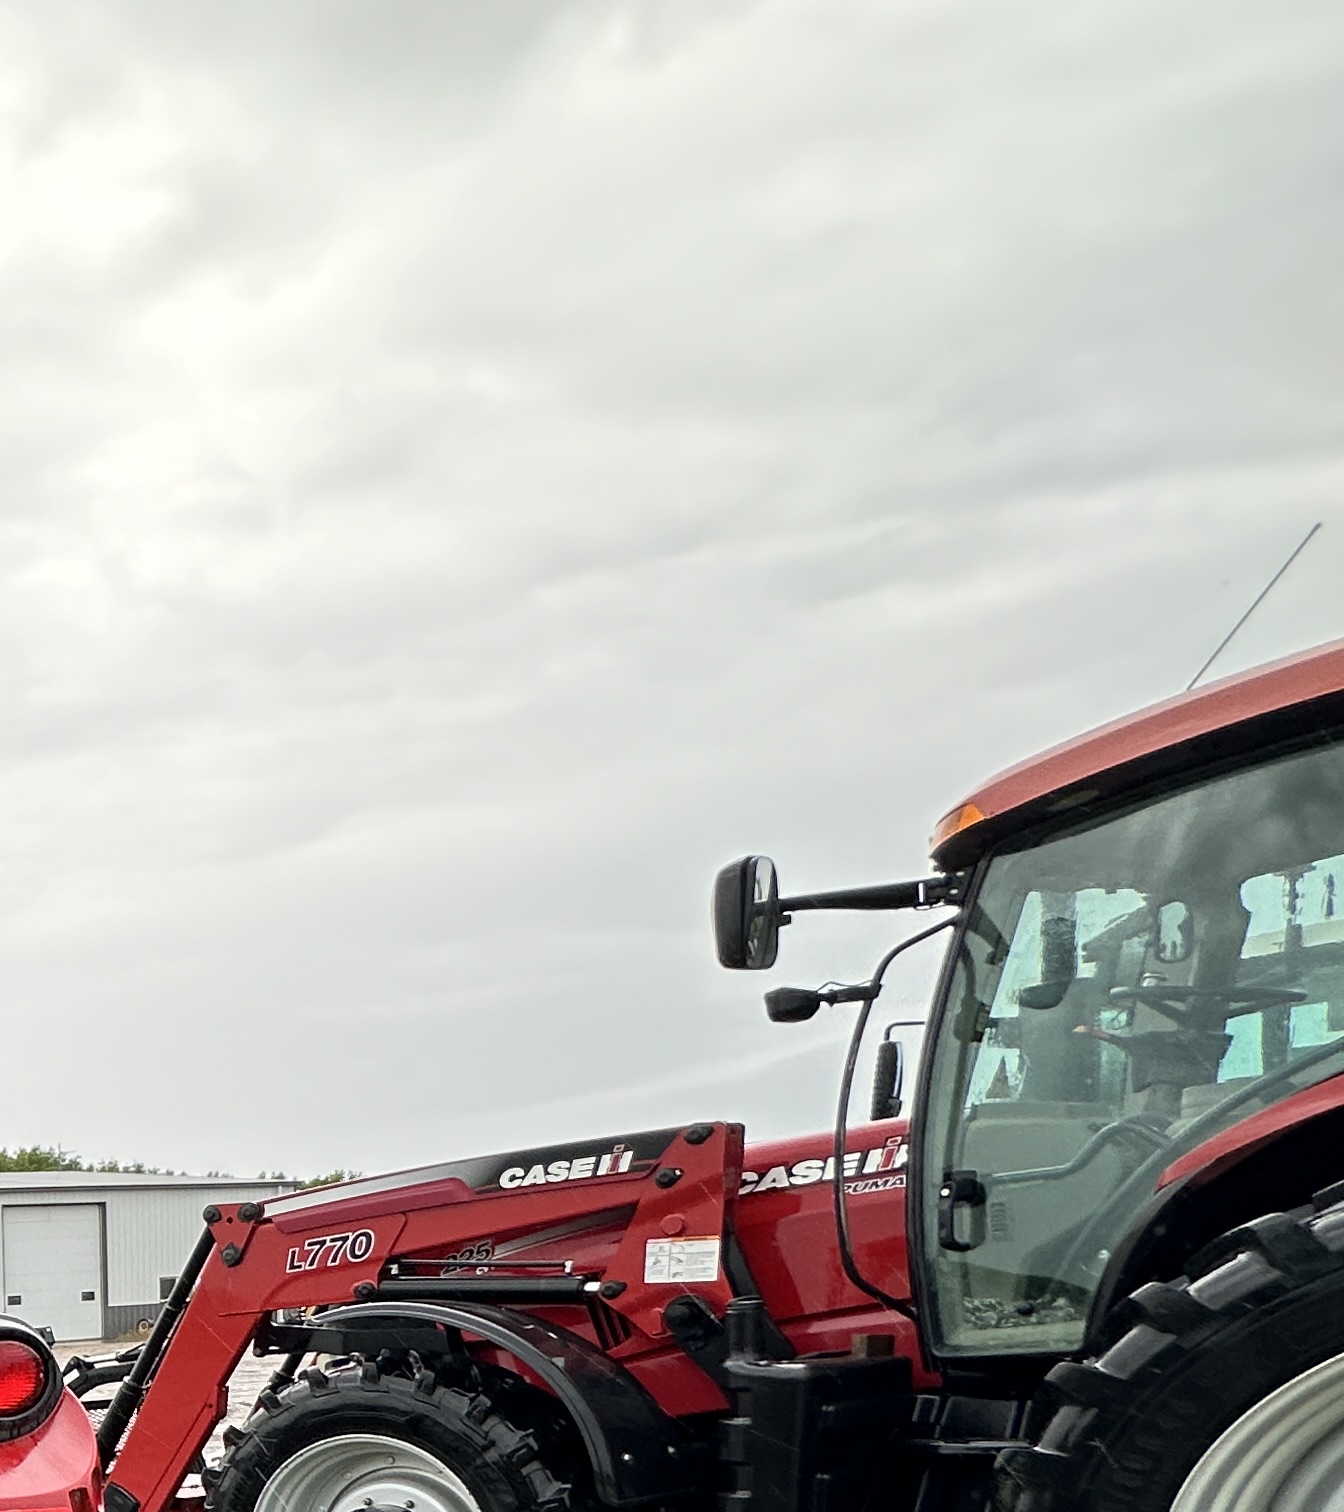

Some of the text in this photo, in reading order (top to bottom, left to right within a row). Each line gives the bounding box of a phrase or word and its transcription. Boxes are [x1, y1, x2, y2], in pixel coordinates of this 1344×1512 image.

[499, 1143, 634, 1189] CASE IH
[285, 1228, 375, 1274] L770
